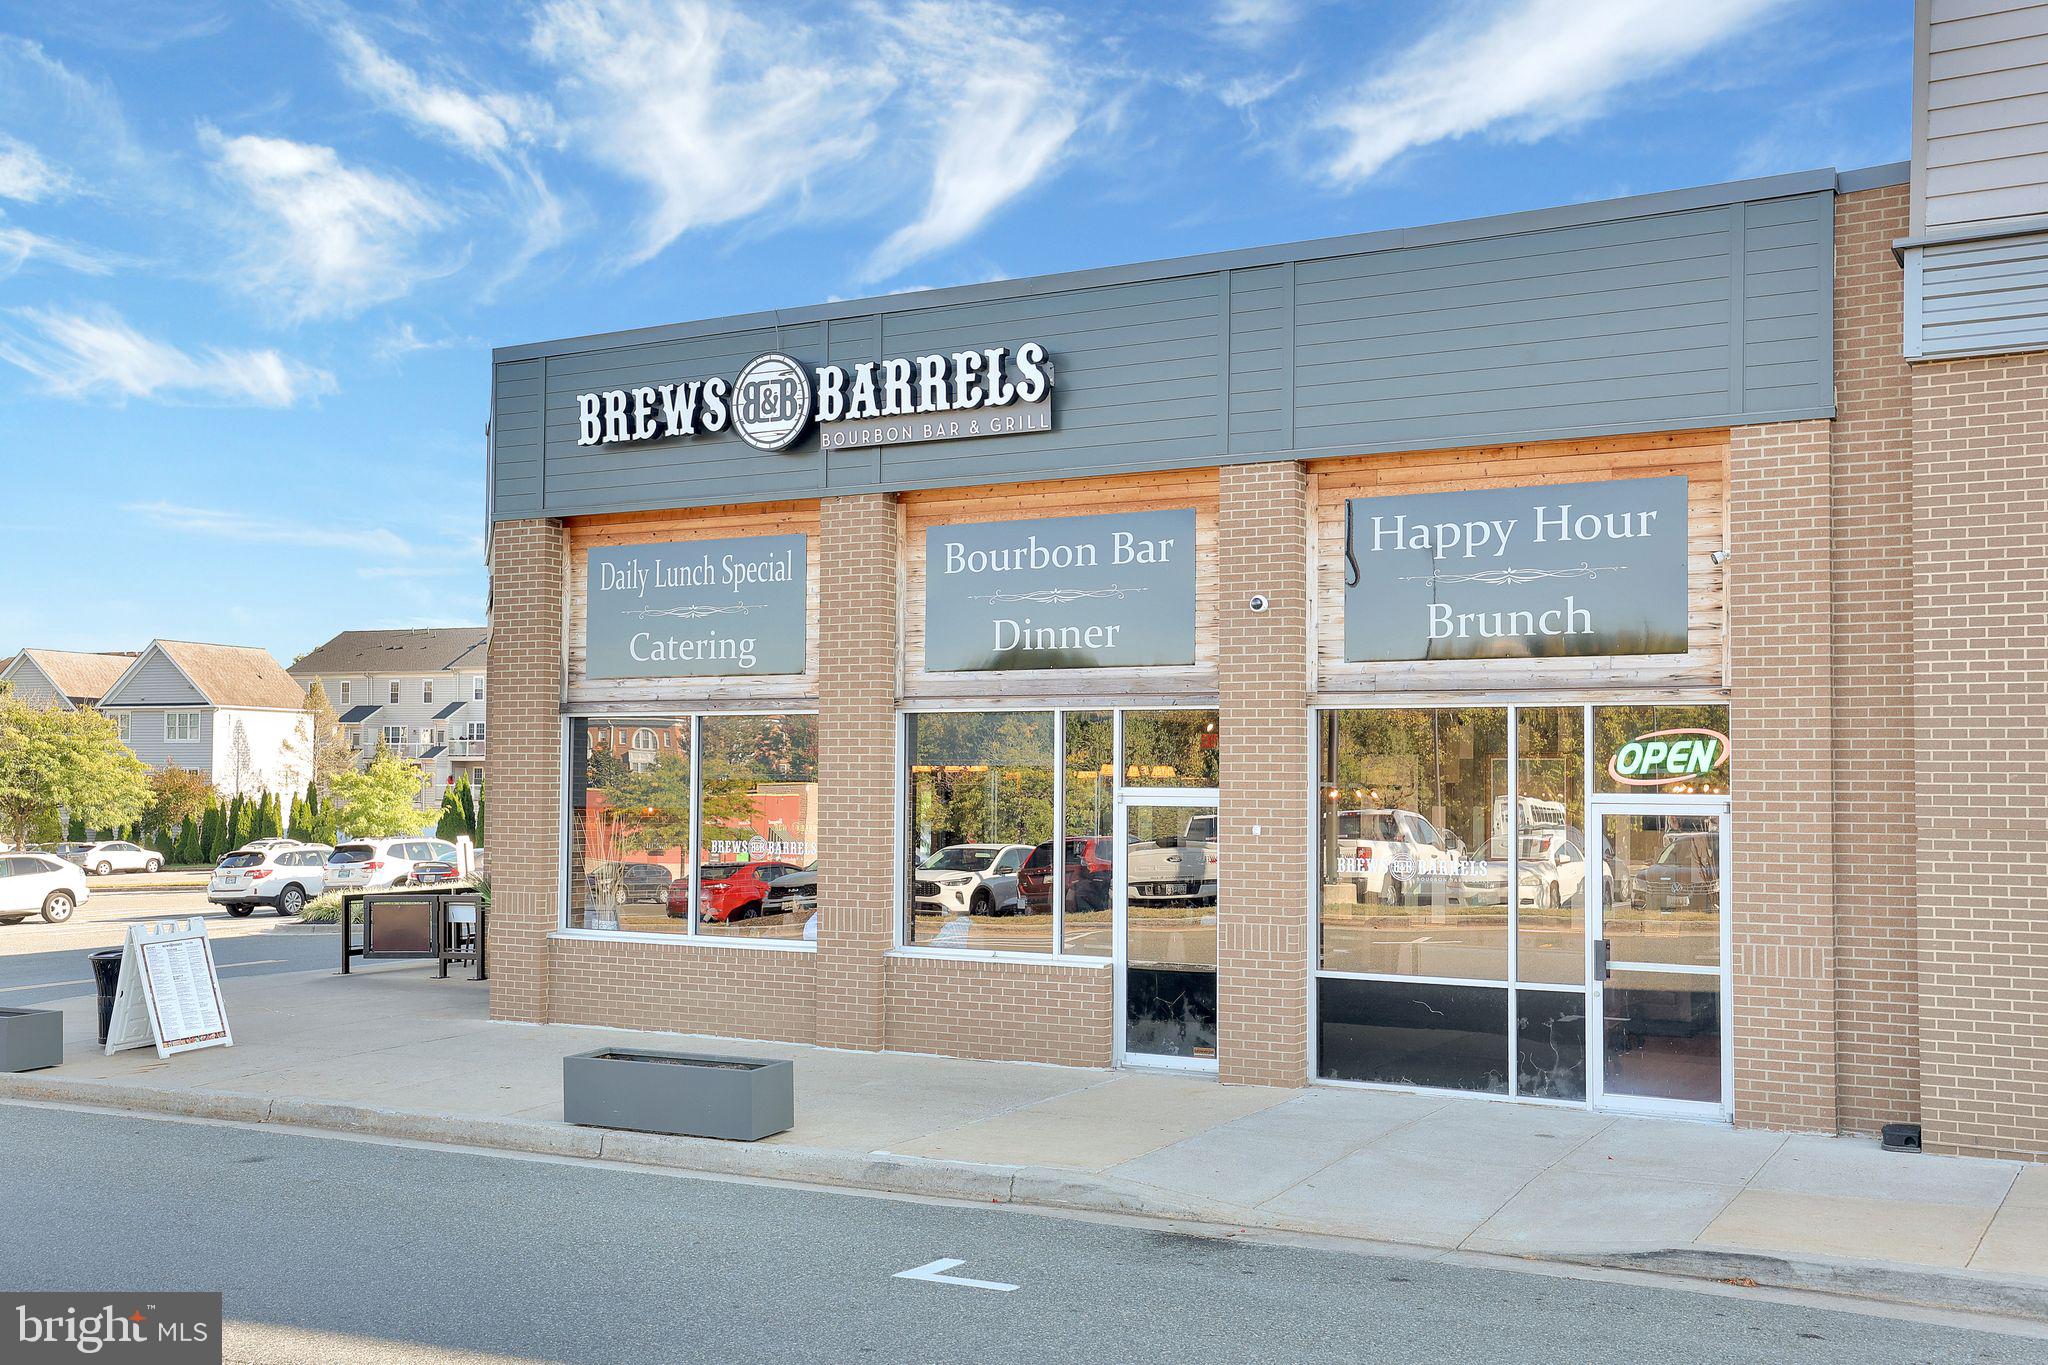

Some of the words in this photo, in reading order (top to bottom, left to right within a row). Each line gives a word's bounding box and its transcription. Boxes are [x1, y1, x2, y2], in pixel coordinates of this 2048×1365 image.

[577, 376, 728, 447] BREWS
[815, 342, 1049, 422] BARRELS
[821, 426, 912, 447] BOURBON
[923, 422, 960, 439] BAR
[969, 420, 980, 434] &
[990, 414, 1049, 432] GRILL
[1370, 514, 1519, 560] Happy
[1533, 504, 1659, 543] Hour
[944, 536, 1098, 574] Bourbon
[1111, 531, 1175, 565] Bar
[600, 558, 650, 598] Daily
[654, 554, 716, 588] Lunch
[721, 549, 793, 593] Special
[993, 618, 1121, 652] Dinner
[1426, 596, 1595, 639] Brunch
[629, 630, 757, 669] Catering
[1616, 738, 1719, 776] OPEN
[711, 840, 748, 854] BREWS
[767, 841, 818, 855] BARRELS
[1337, 857, 1388, 873] BREW
